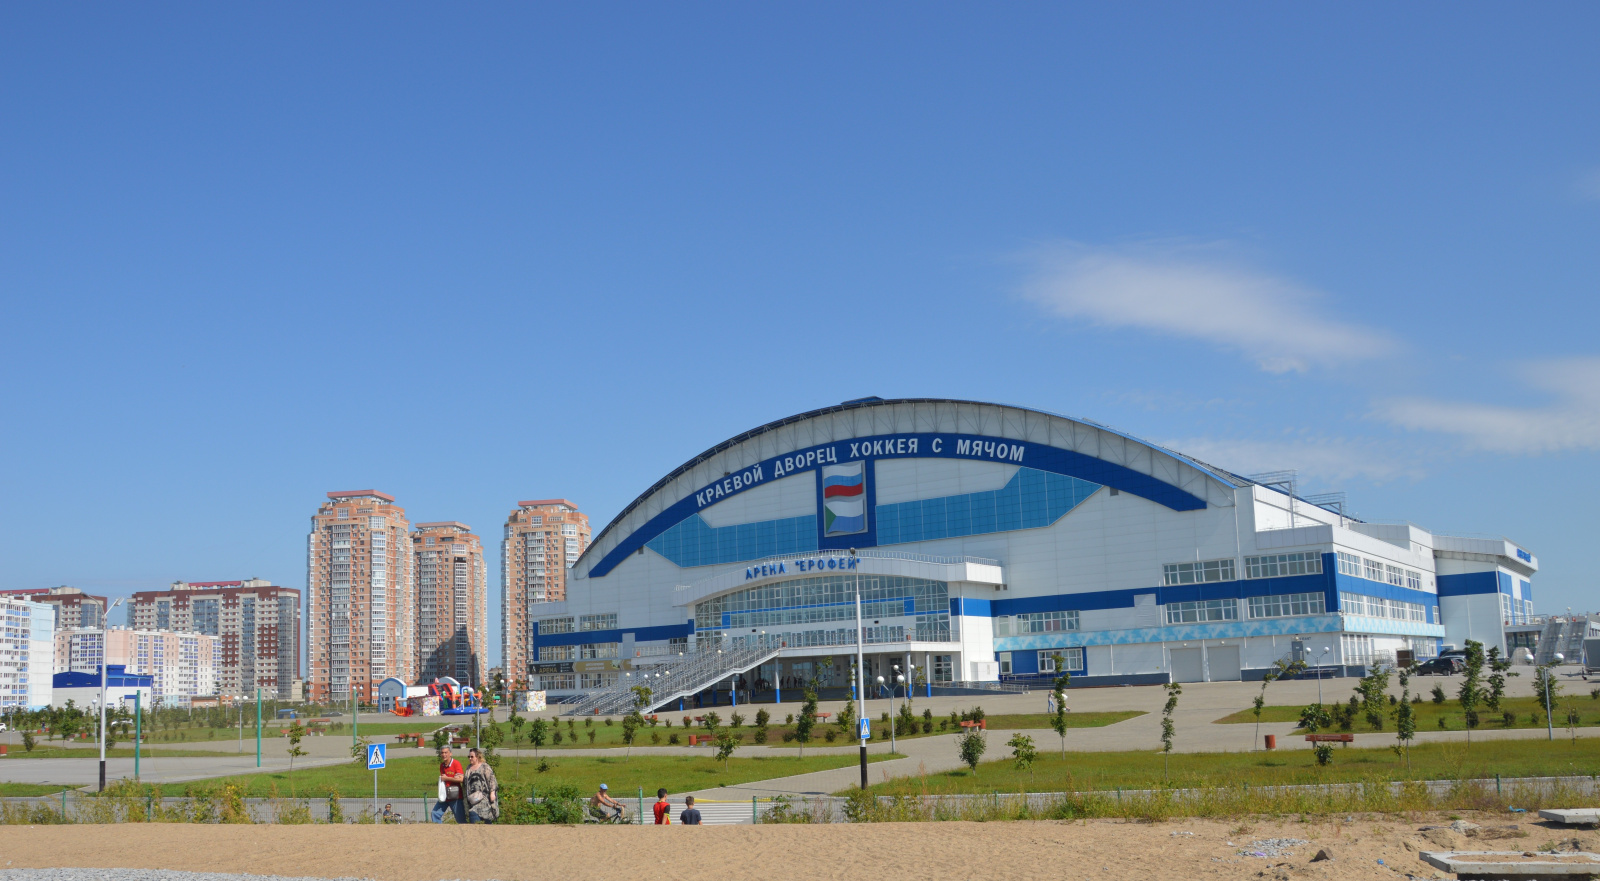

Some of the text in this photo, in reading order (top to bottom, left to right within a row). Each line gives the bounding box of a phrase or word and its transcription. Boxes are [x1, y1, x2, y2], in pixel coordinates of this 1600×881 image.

[696, 438, 1025, 507] КРАЕВОЙ ДВОРЕЦ ХОККЕЯ С МЯЧОМ
[745, 562, 786, 580] АРЕНА
